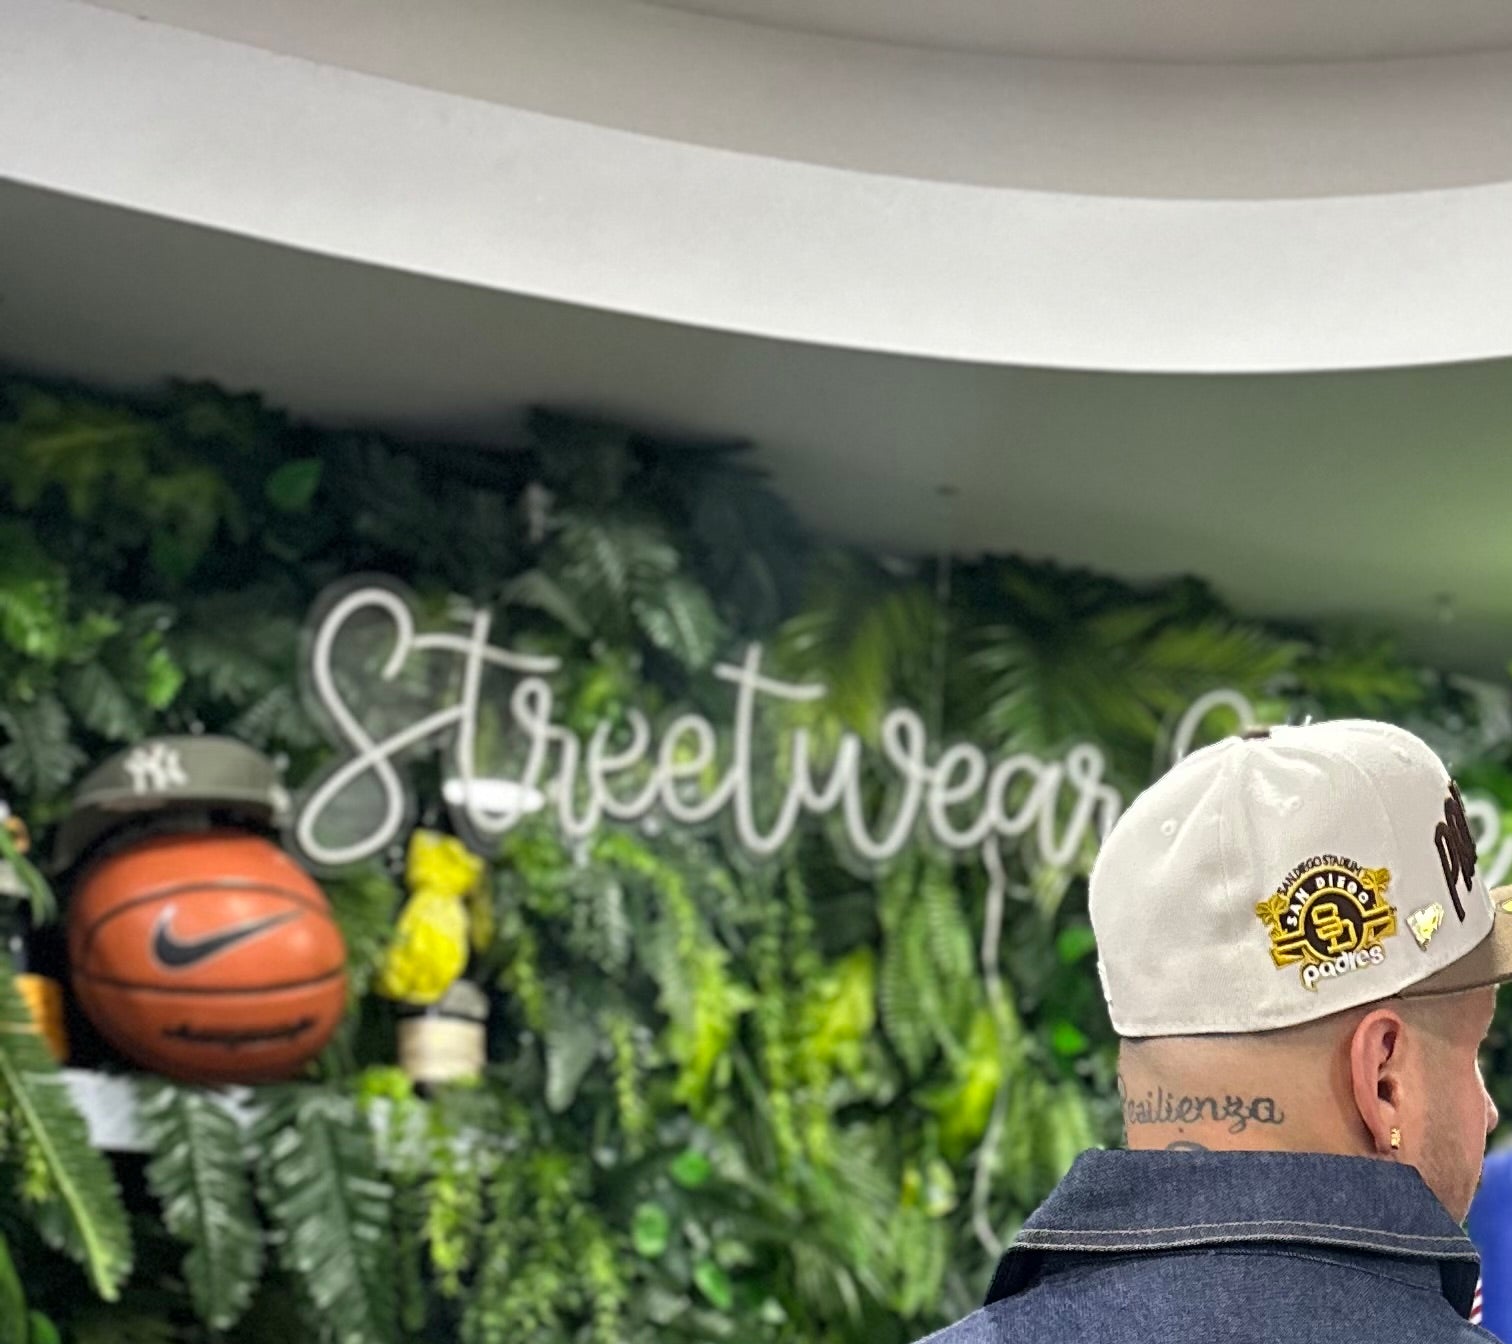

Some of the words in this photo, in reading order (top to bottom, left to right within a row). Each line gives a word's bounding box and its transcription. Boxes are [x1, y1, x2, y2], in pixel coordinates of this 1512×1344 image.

[296, 588, 1120, 864] Streetwear
[1286, 887, 1310, 927] SAN
[1315, 873, 1369, 904] DIEGO
